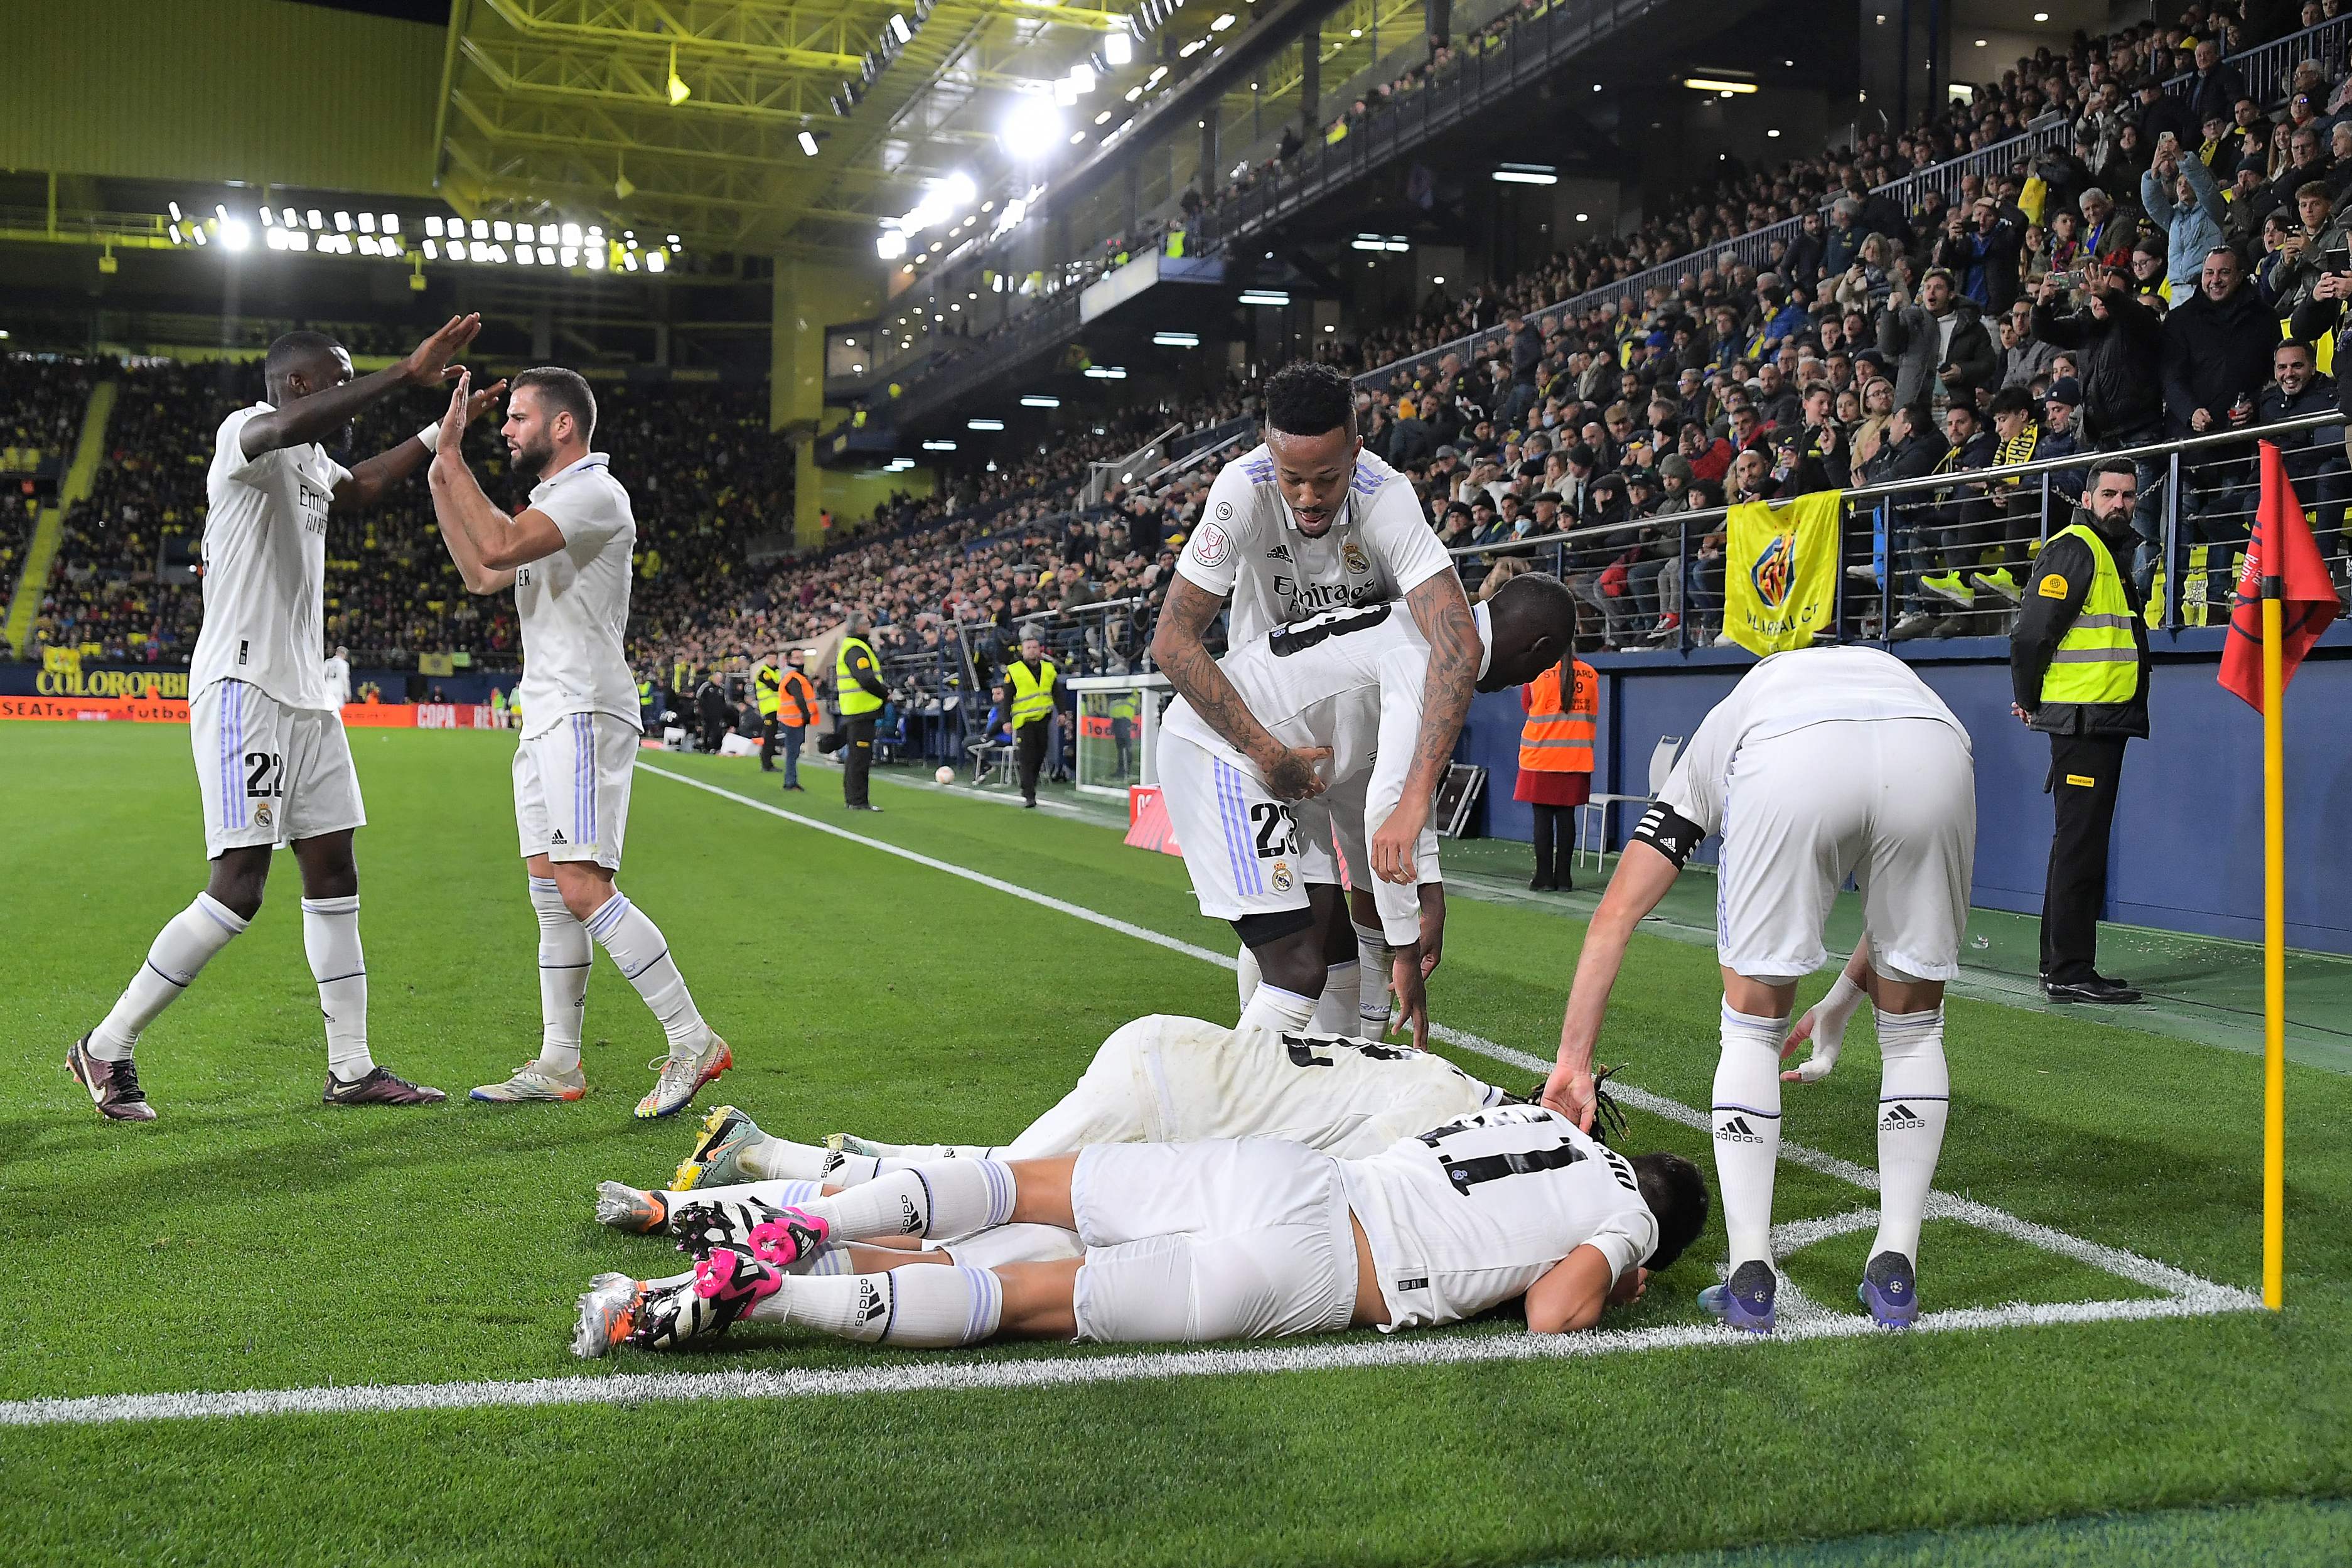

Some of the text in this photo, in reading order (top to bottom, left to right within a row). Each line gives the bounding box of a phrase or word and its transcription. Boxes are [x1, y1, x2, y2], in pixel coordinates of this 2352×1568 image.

[1219, 506, 1229, 515] 19
[1267, 550, 1294, 564] adidas
[1544, 670, 1593, 679] STARD
[1659, 838, 1677, 853] adidas
[1879, 1117, 1926, 1130] adidas
[1715, 1129, 1764, 1144] adidas
[854, 1279, 871, 1327] adidas
